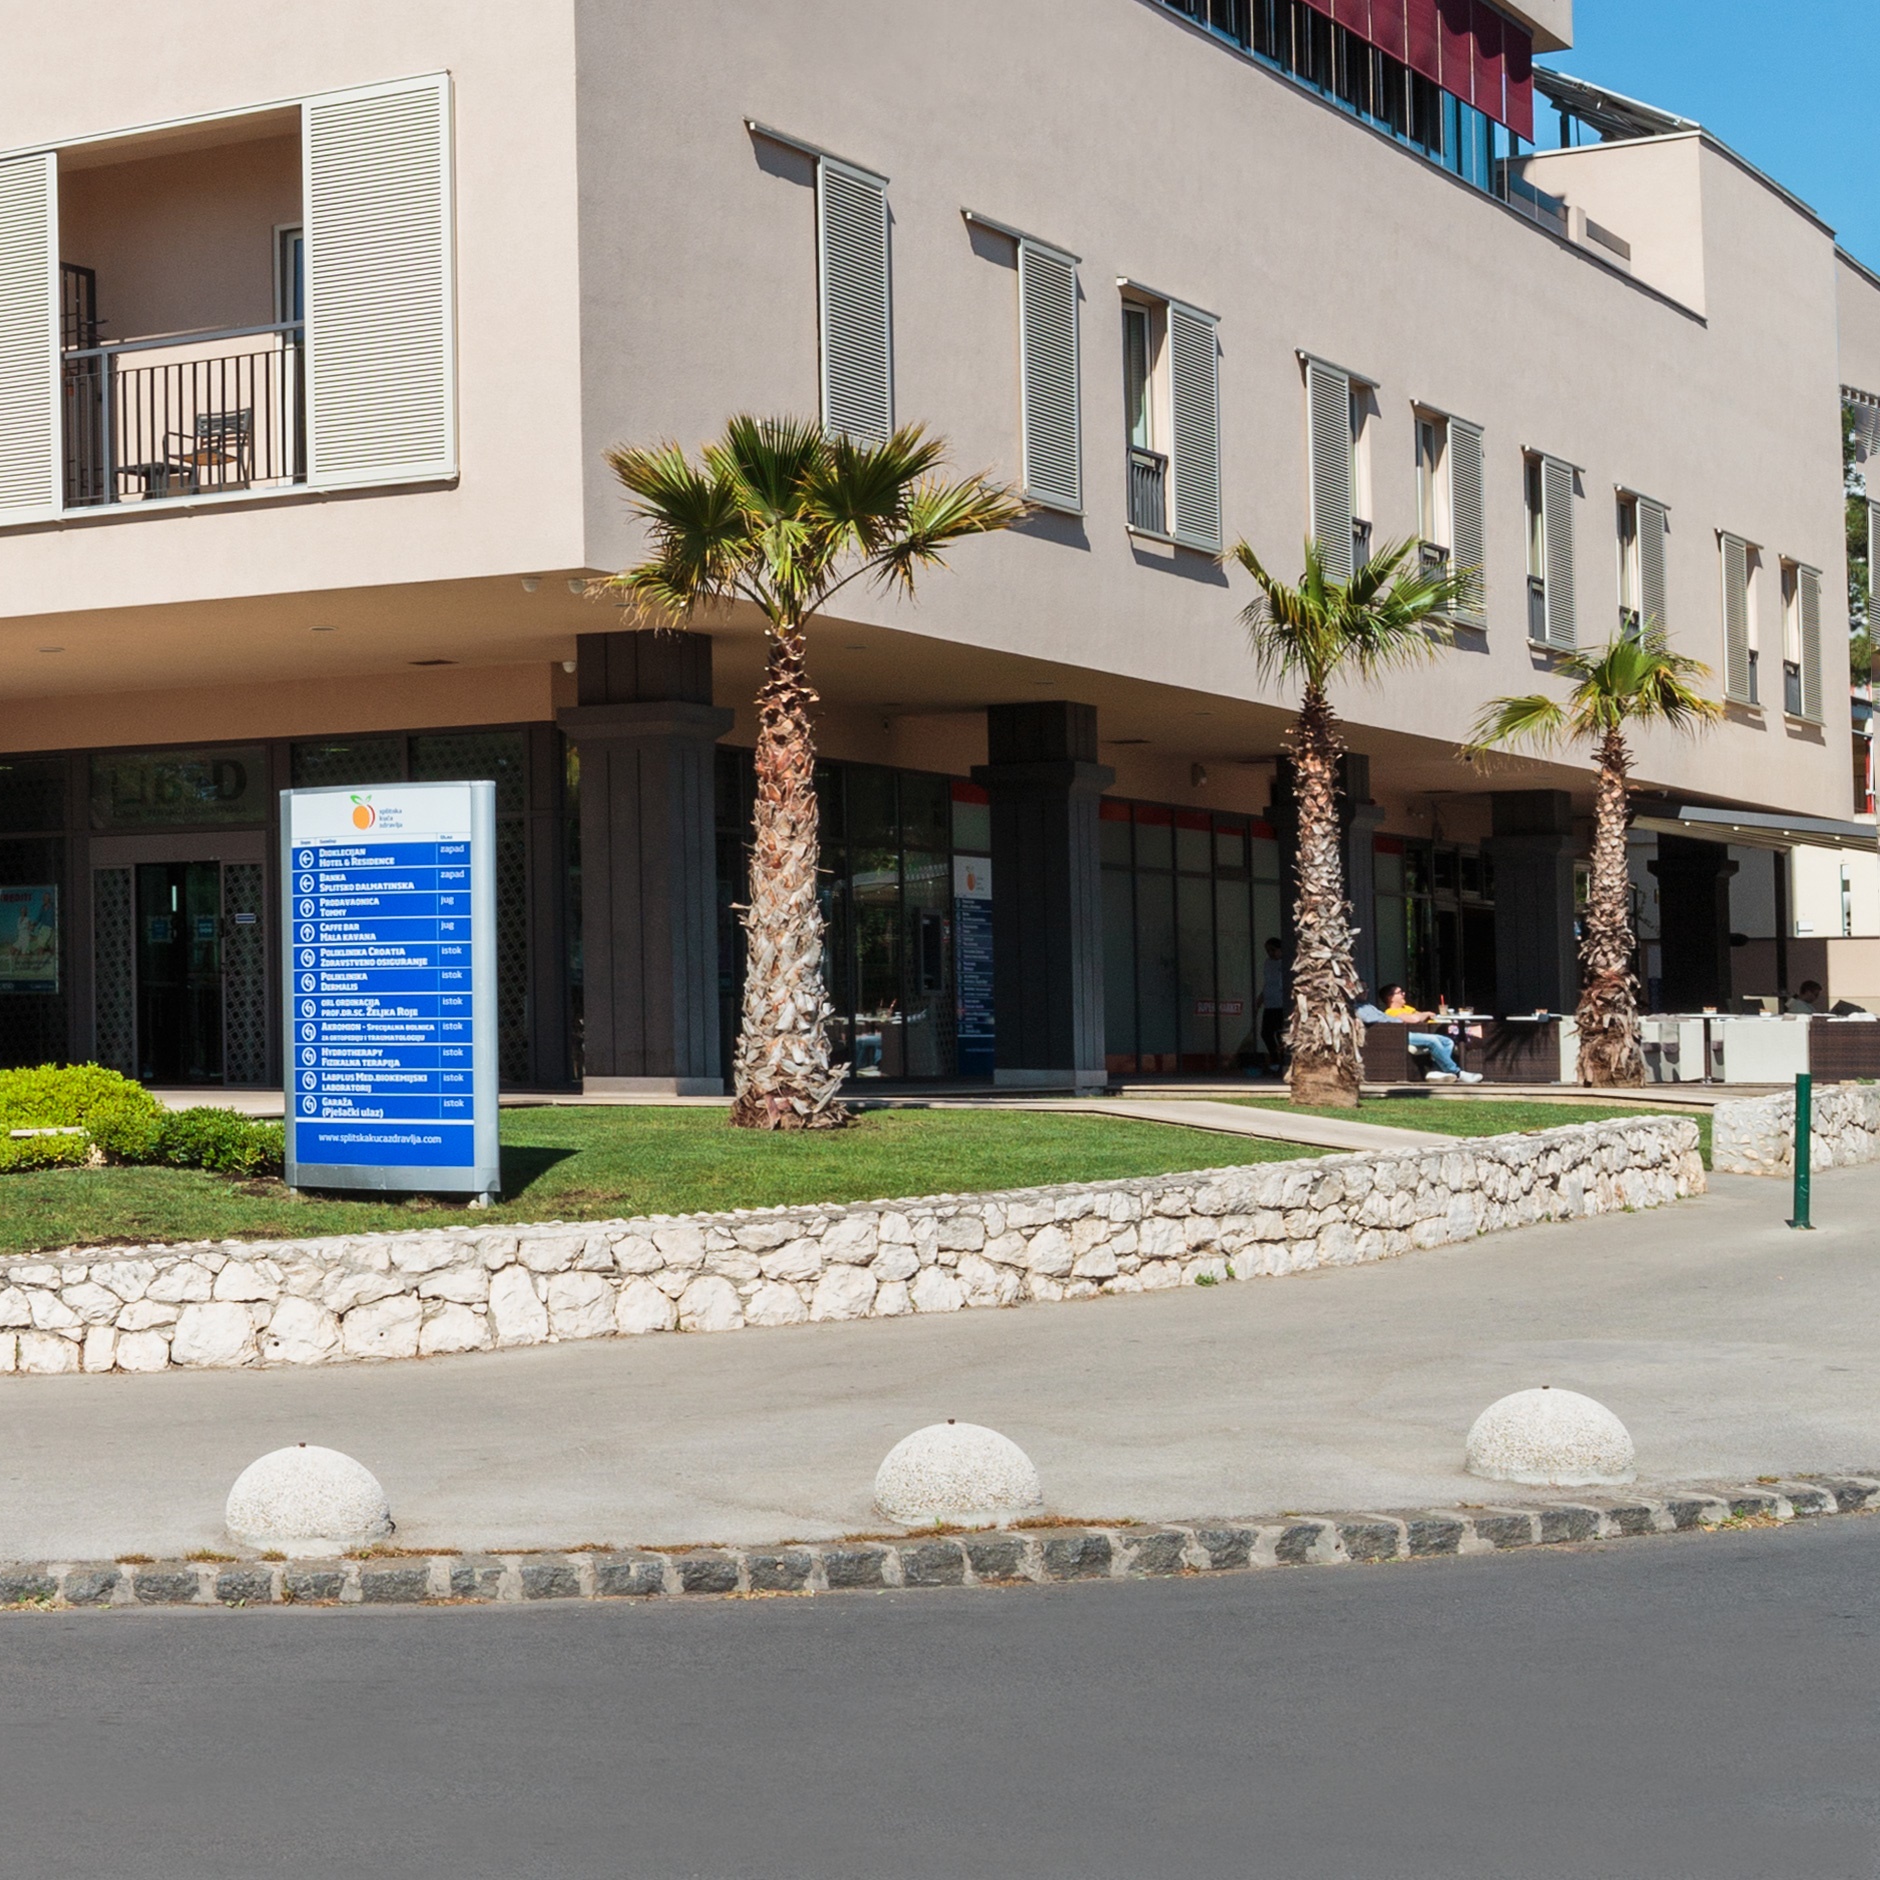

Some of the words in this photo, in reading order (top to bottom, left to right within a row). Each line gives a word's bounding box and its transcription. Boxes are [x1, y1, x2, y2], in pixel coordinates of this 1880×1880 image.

[440, 845, 464, 854] zapad
[440, 870, 464, 879] zapad
[441, 896, 454, 905] jug
[441, 921, 454, 930] jug
[442, 947, 462, 955] istok
[442, 971, 462, 979] istok
[442, 997, 463, 1005] istok
[442, 1022, 463, 1030] istok
[443, 1048, 463, 1056] istok
[443, 1074, 464, 1082] istok
[443, 1099, 464, 1107] istok
[361, 1108, 384, 1117] ulaz)
